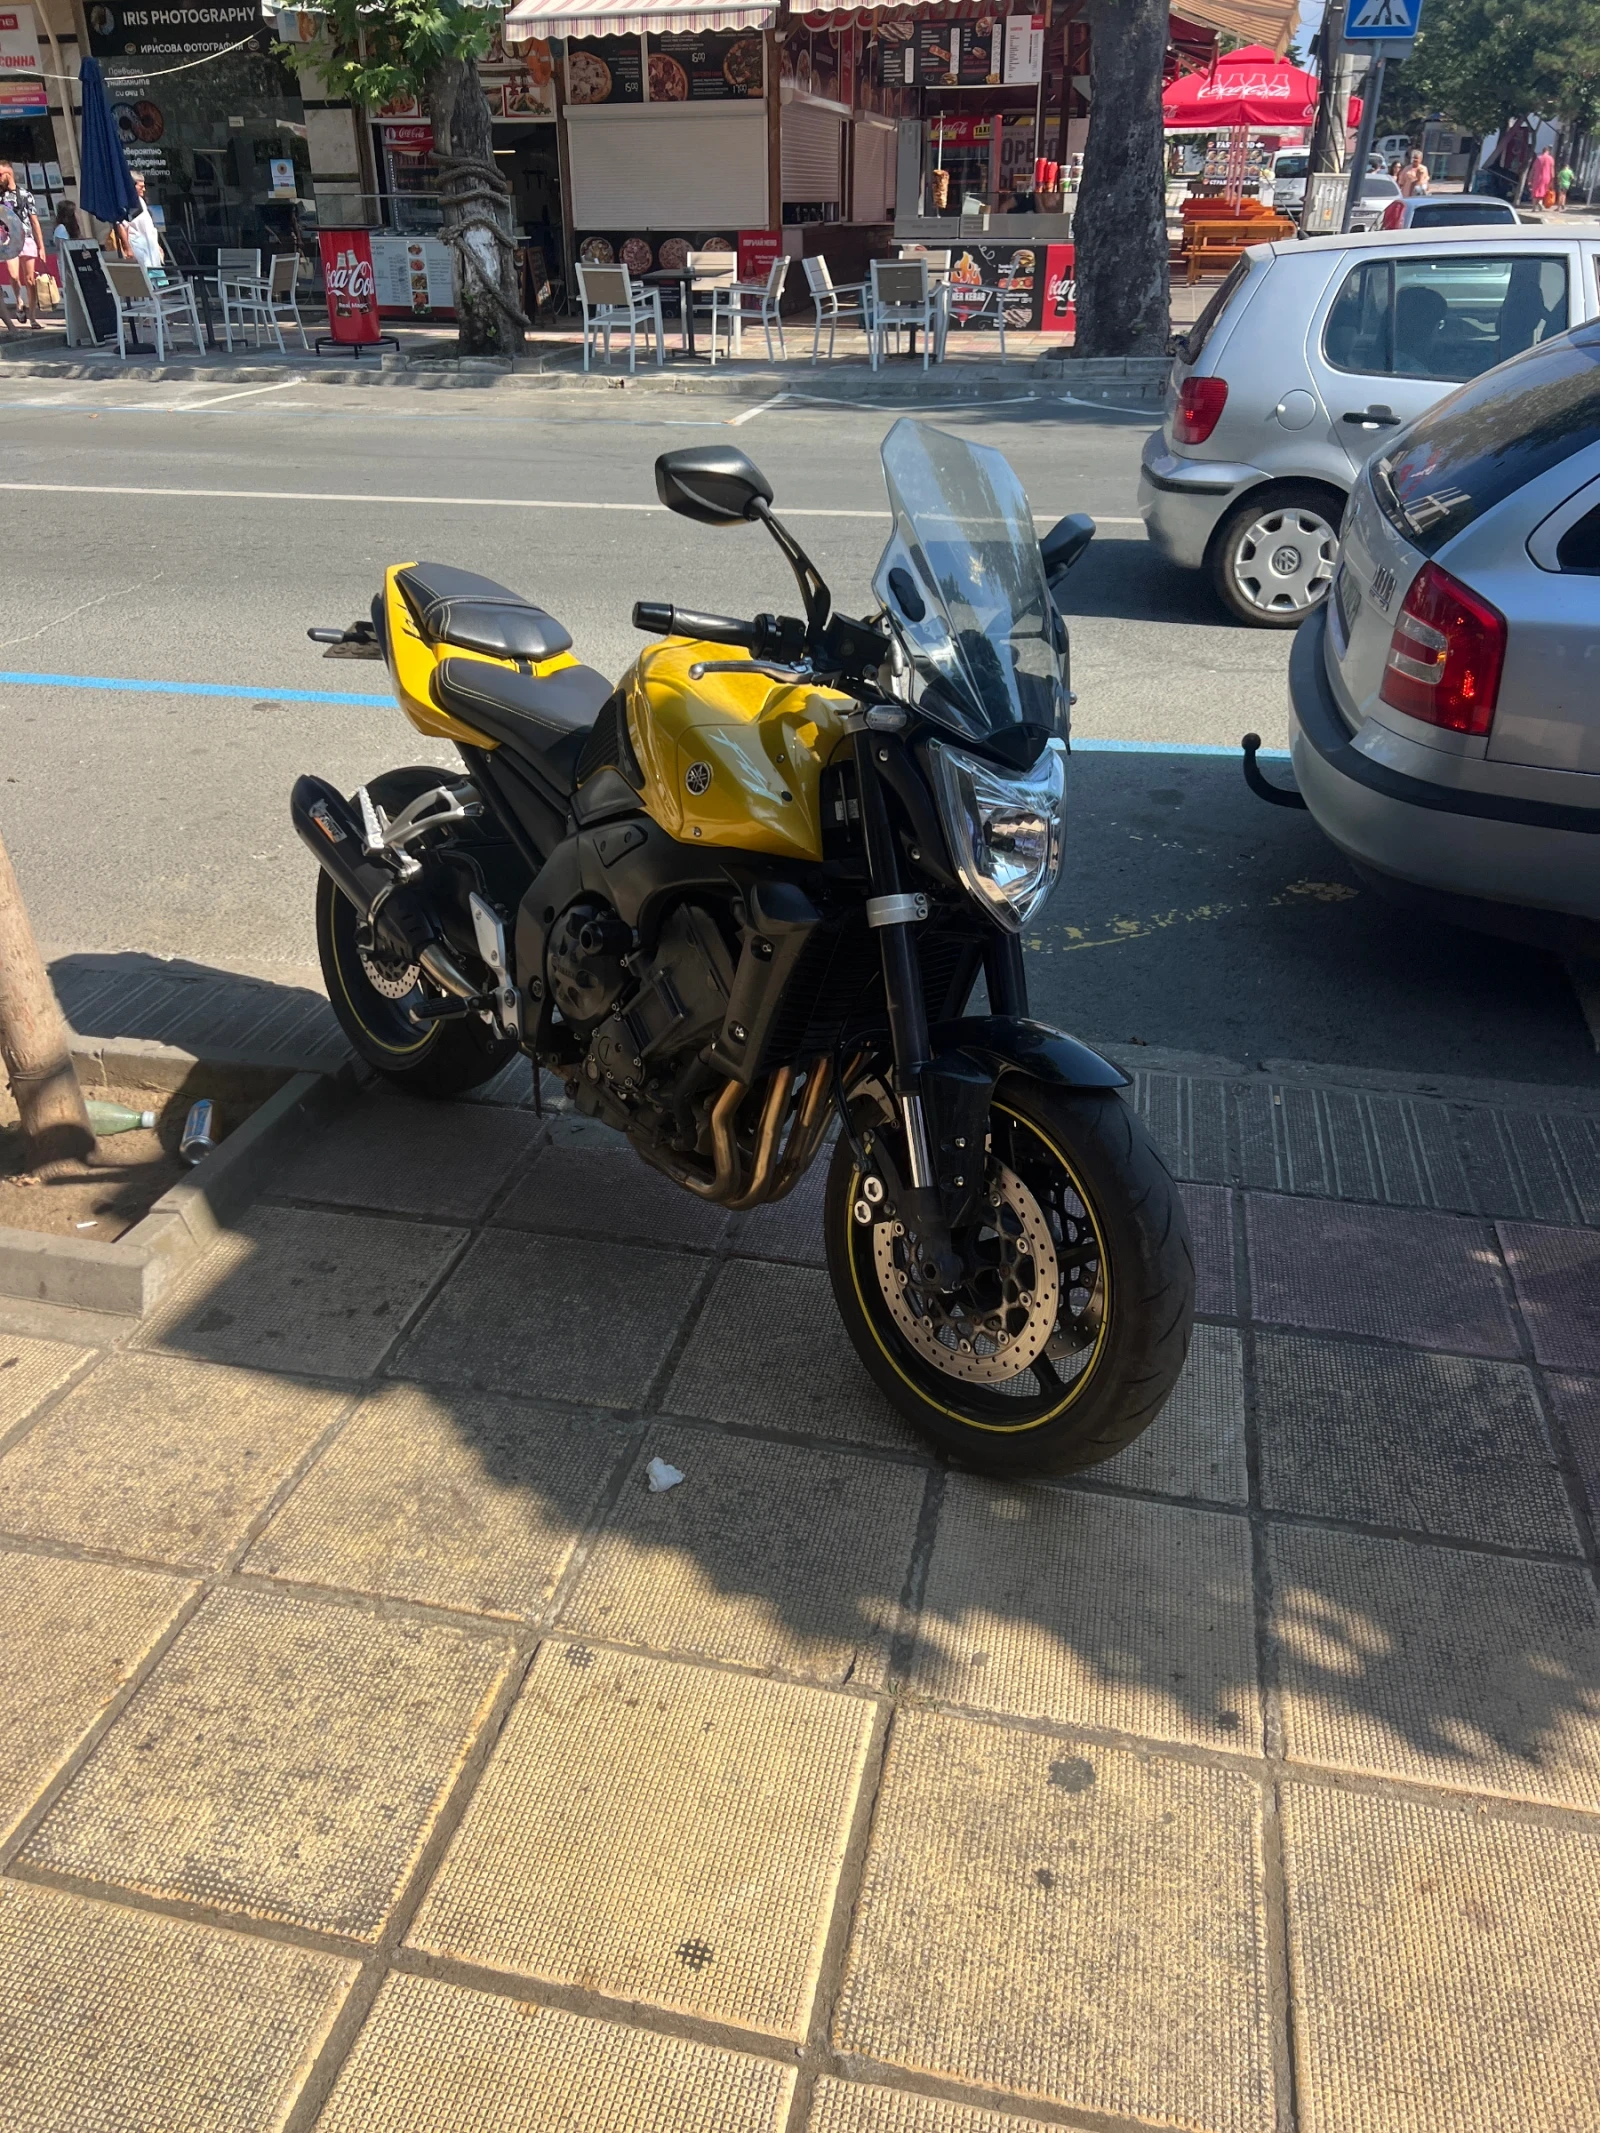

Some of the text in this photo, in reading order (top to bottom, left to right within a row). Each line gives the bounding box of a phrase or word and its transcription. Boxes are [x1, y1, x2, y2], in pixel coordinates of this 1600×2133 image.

[123, 6, 256, 26] IRIS PHOTOGRAPHY
[140, 41, 244, 54] ИРИСОВА ФОТОГРАФИЯ
[398, 127, 425, 139] Coca-Cola
[934, 121, 968, 135] Cca-Cola
[123, 147, 162, 156] вероятно
[127, 158, 167, 167] изведение
[965, 292, 987, 302] KEBAB
